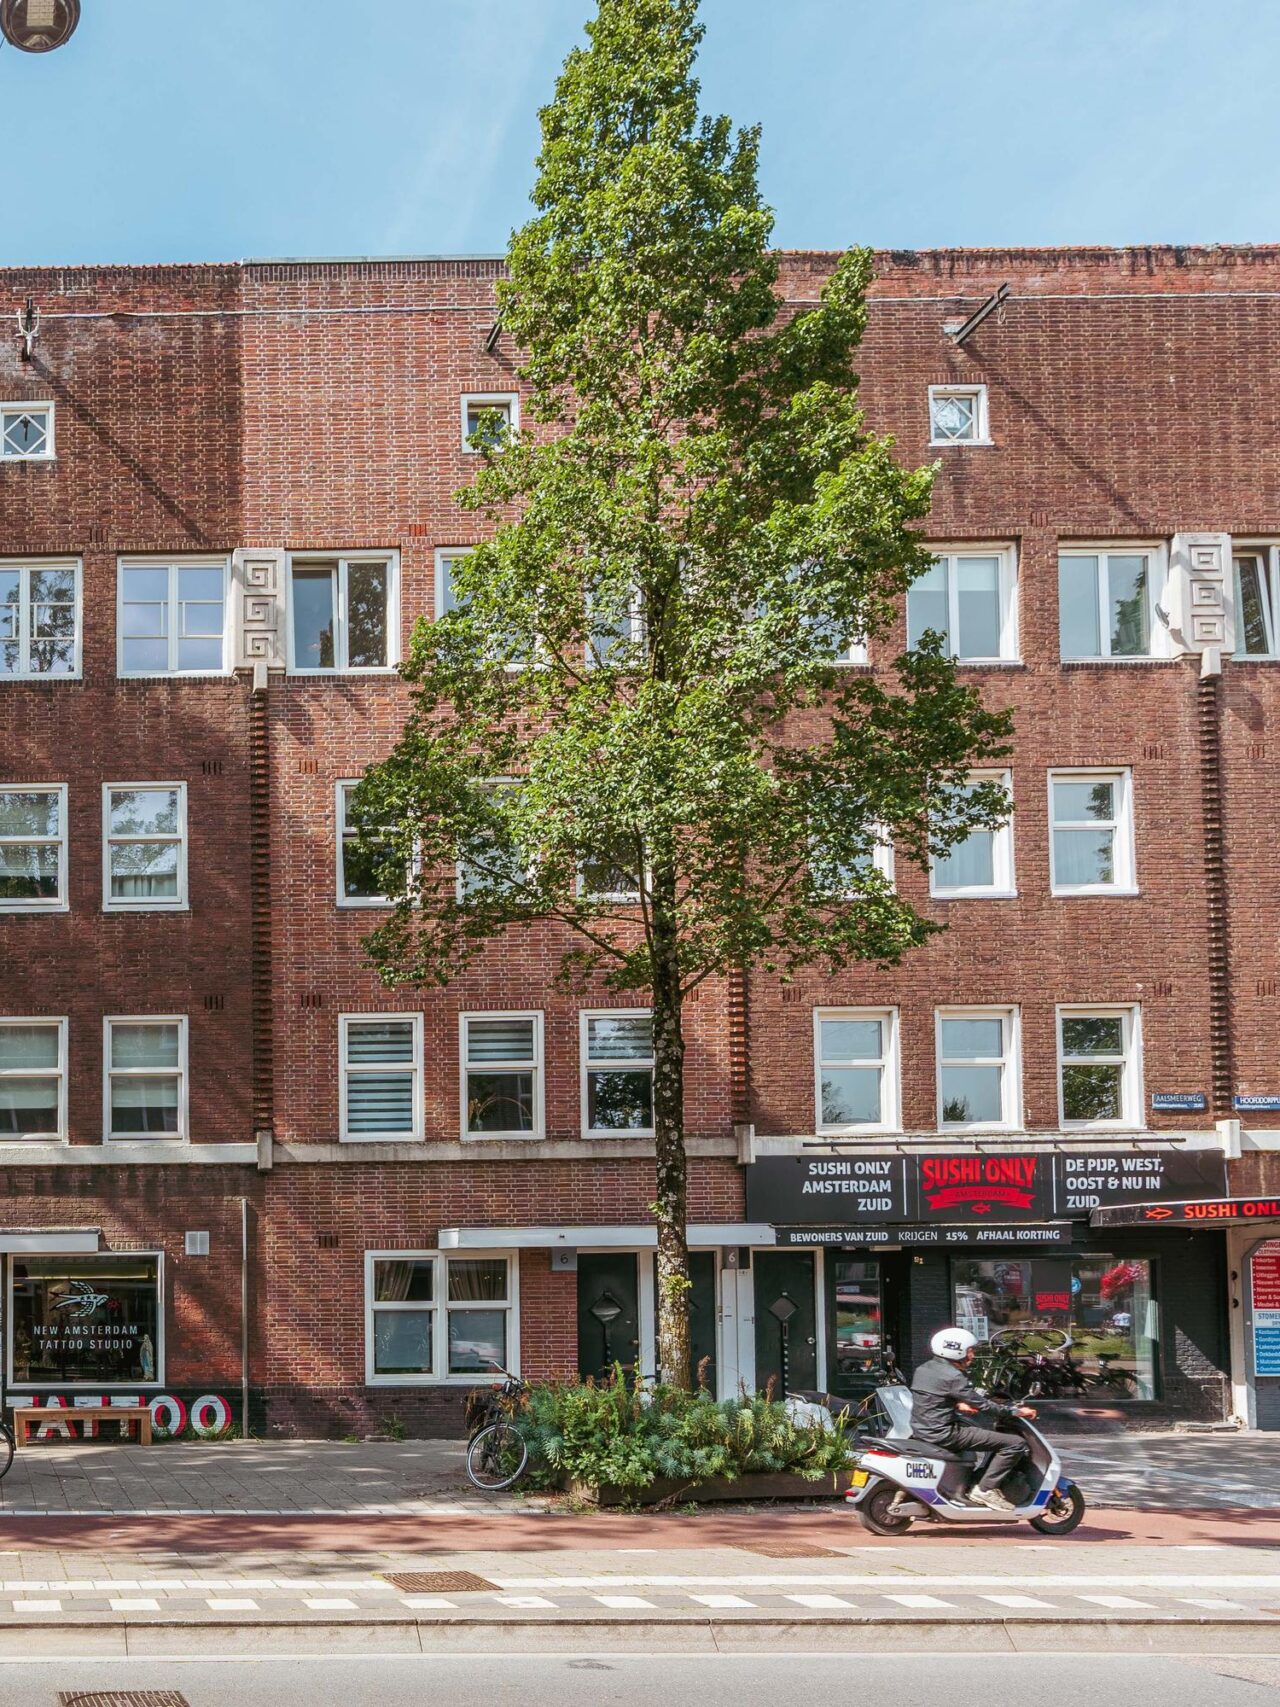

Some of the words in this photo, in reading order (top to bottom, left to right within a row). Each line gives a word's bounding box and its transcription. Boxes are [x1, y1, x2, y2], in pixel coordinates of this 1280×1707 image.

[809, 1163, 851, 1175] SUSHI
[855, 1162, 891, 1174] ONLY
[1066, 1159, 1084, 1171] DE
[1088, 1159, 1119, 1172] PIJP,
[1122, 1158, 1164, 1172] WEST,
[922, 1158, 981, 1190] SUSHI
[985, 1158, 1036, 1188] ONLY
[802, 1180, 891, 1193] AMSTERDAM
[1066, 1177, 1104, 1190] OOST
[1107, 1177, 1119, 1189] &
[1122, 1177, 1142, 1189] NU
[1146, 1176, 1160, 1189] IN
[858, 1198, 892, 1211] ZUID
[1066, 1195, 1100, 1208] ZUID
[1184, 1204, 1237, 1218] SUSHI
[1243, 1202, 1280, 1216] ONL
[790, 1233, 842, 1242] BEWONERS
[844, 1233, 864, 1241] VAN
[866, 1232, 888, 1241] ZUID
[898, 1231, 938, 1241] KRIJGEN
[946, 1231, 968, 1240] 15%
[976, 1231, 1014, 1240] AFHAAL
[1017, 1230, 1060, 1240] KORTING
[560, 1254, 568, 1264] 6
[728, 1253, 736, 1263] 6
[33, 1325, 58, 1335] NEW
[64, 1325, 138, 1335] AMSTERDAM
[39, 1340, 83, 1350] TATTOO
[89, 1339, 133, 1349] STUDIO
